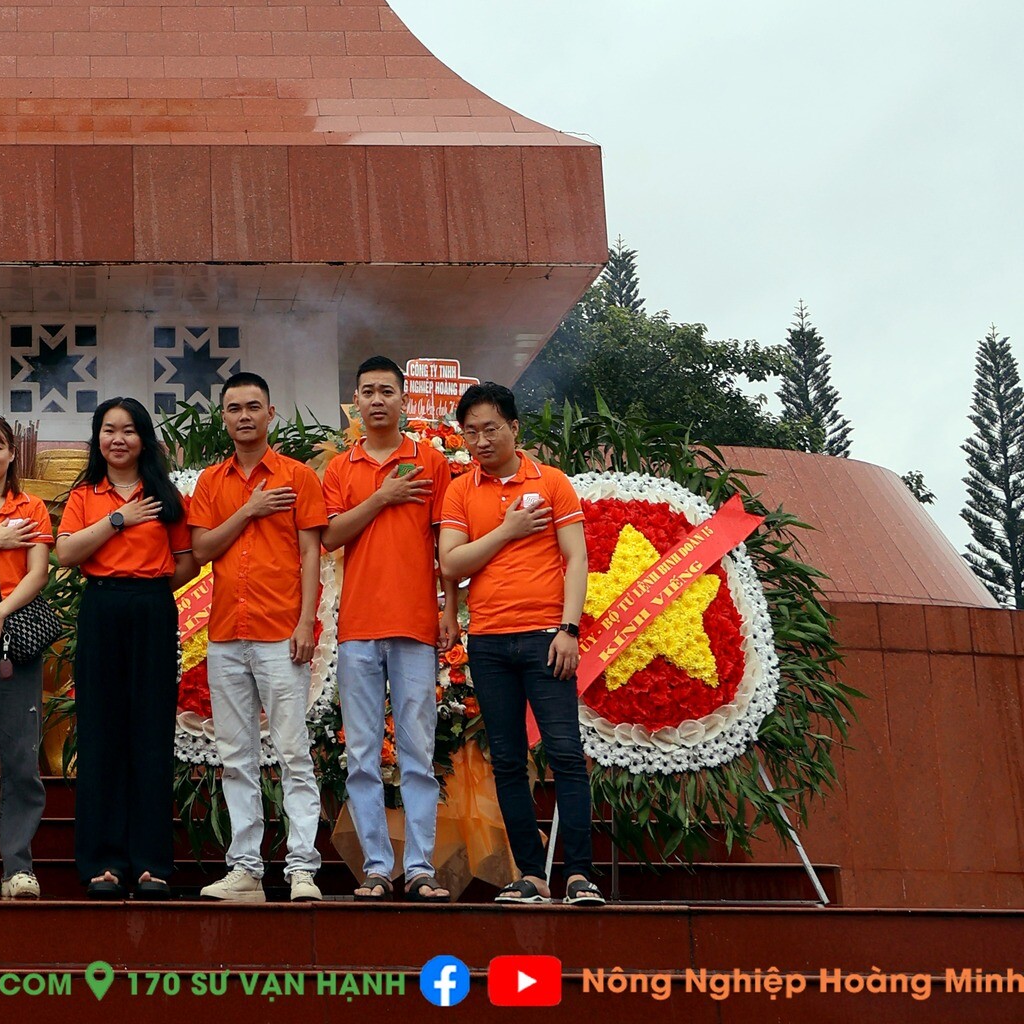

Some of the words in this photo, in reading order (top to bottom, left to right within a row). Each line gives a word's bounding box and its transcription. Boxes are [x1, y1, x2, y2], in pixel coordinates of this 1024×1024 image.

[410, 362, 428, 377] CÔNG
[439, 365, 456, 379] TNHH
[435, 379, 458, 396] HOÀNG
[600, 609, 621, 631] BỘ
[616, 592, 635, 612] TƯ
[632, 570, 661, 598] LỆNH
[656, 552, 683, 575] BINH
[700, 525, 714, 538] 15
[598, 607, 652, 663] KÍNH
[649, 560, 704, 606] VIẾNG
